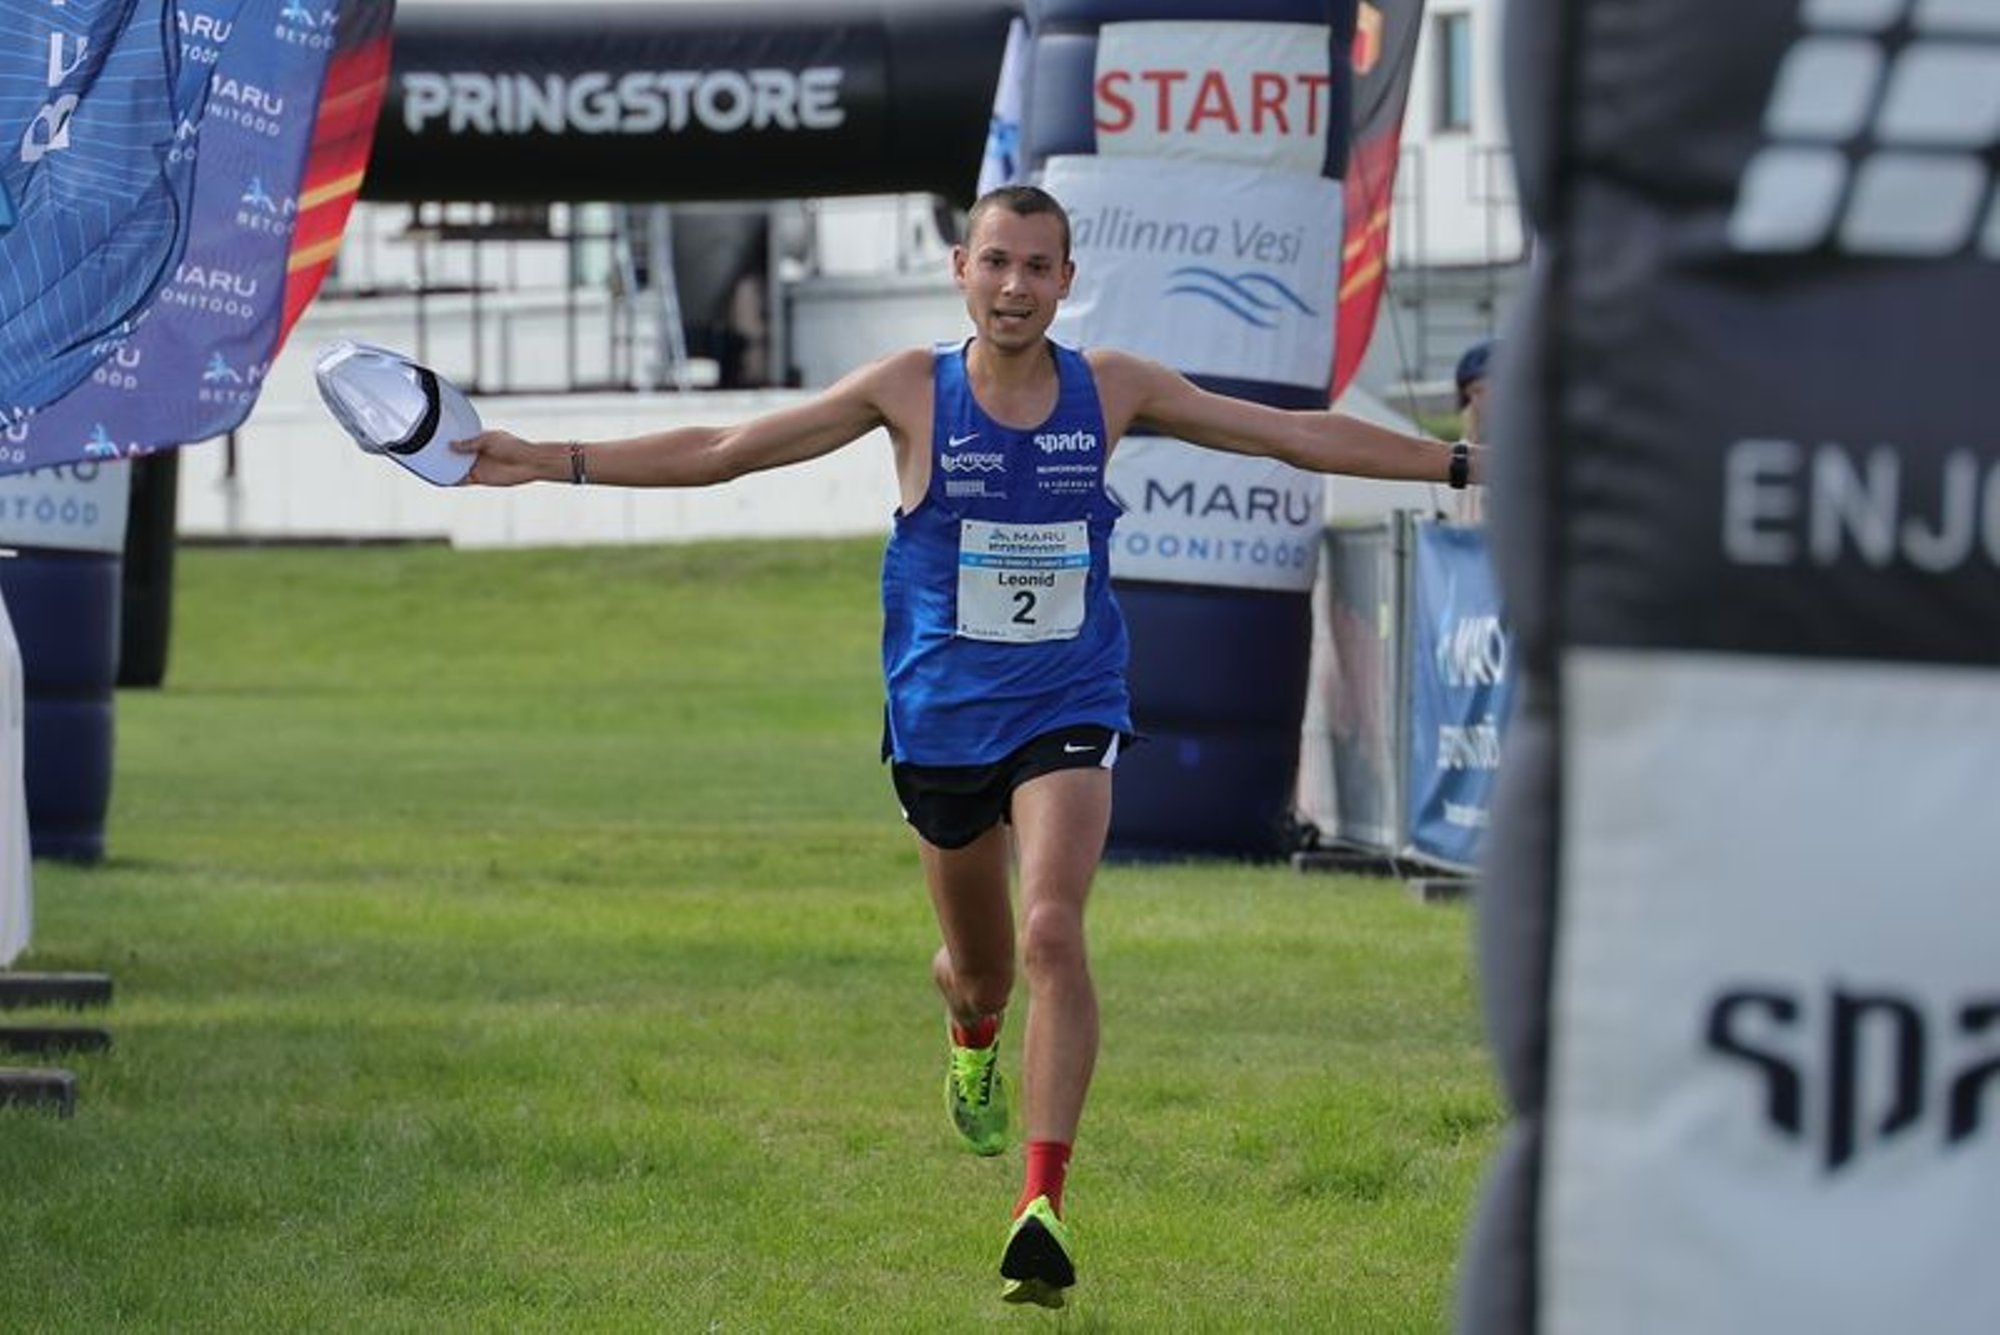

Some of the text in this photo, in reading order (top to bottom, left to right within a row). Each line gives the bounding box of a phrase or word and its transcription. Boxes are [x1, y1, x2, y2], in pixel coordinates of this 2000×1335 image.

[1095, 70, 1330, 137] START
[1068, 206, 1305, 264] allinna Vesi
[1033, 430, 1097, 453] sparta
[1144, 480, 1311, 527] MARU
[1722, 438, 2000, 571] ENJ
[998, 571, 1055, 588] Leonid
[1012, 590, 1036, 625] 2
